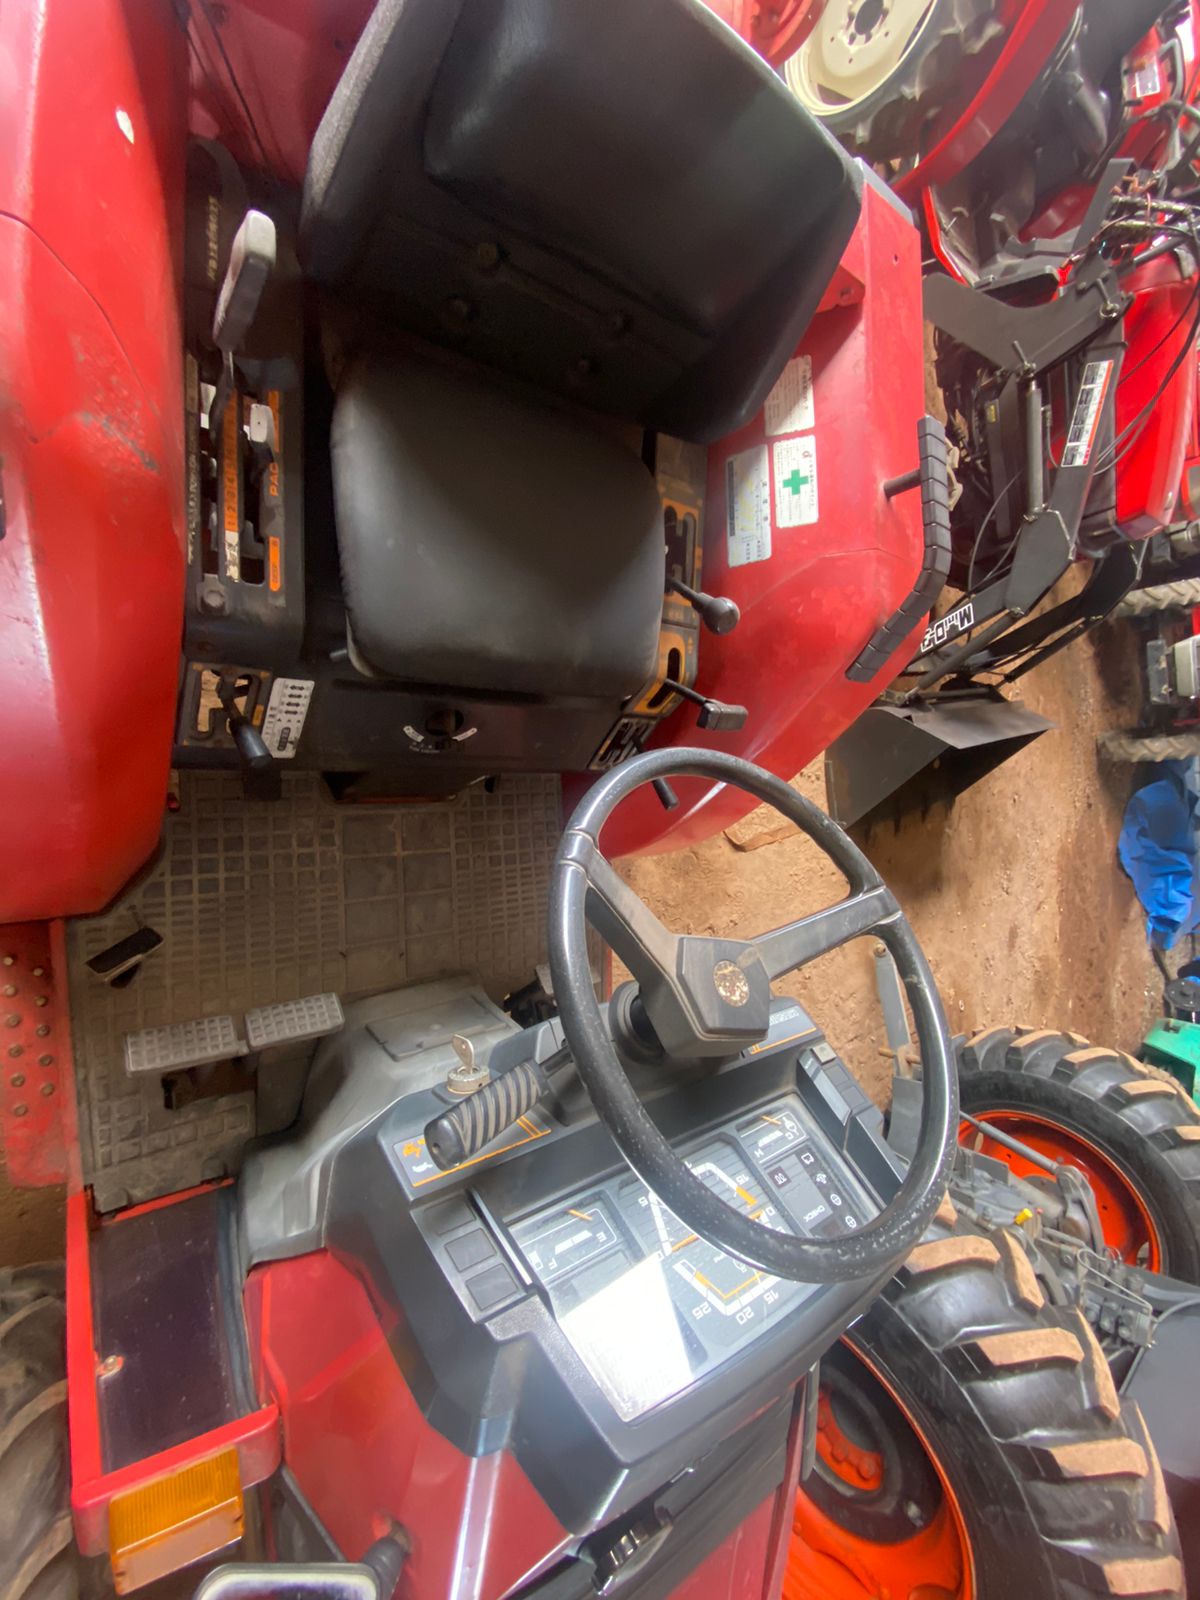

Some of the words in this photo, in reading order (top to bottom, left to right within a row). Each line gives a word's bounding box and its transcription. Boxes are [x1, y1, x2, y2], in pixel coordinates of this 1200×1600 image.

[754, 1149, 764, 1158] H
[736, 1173, 749, 1185] 15
[803, 1205, 825, 1222] CHECK
[596, 1231, 607, 1242] E
[548, 1257, 558, 1270] F
[763, 1289, 780, 1305] 15
[692, 1301, 712, 1320] 25
[736, 1306, 754, 1325] 20
